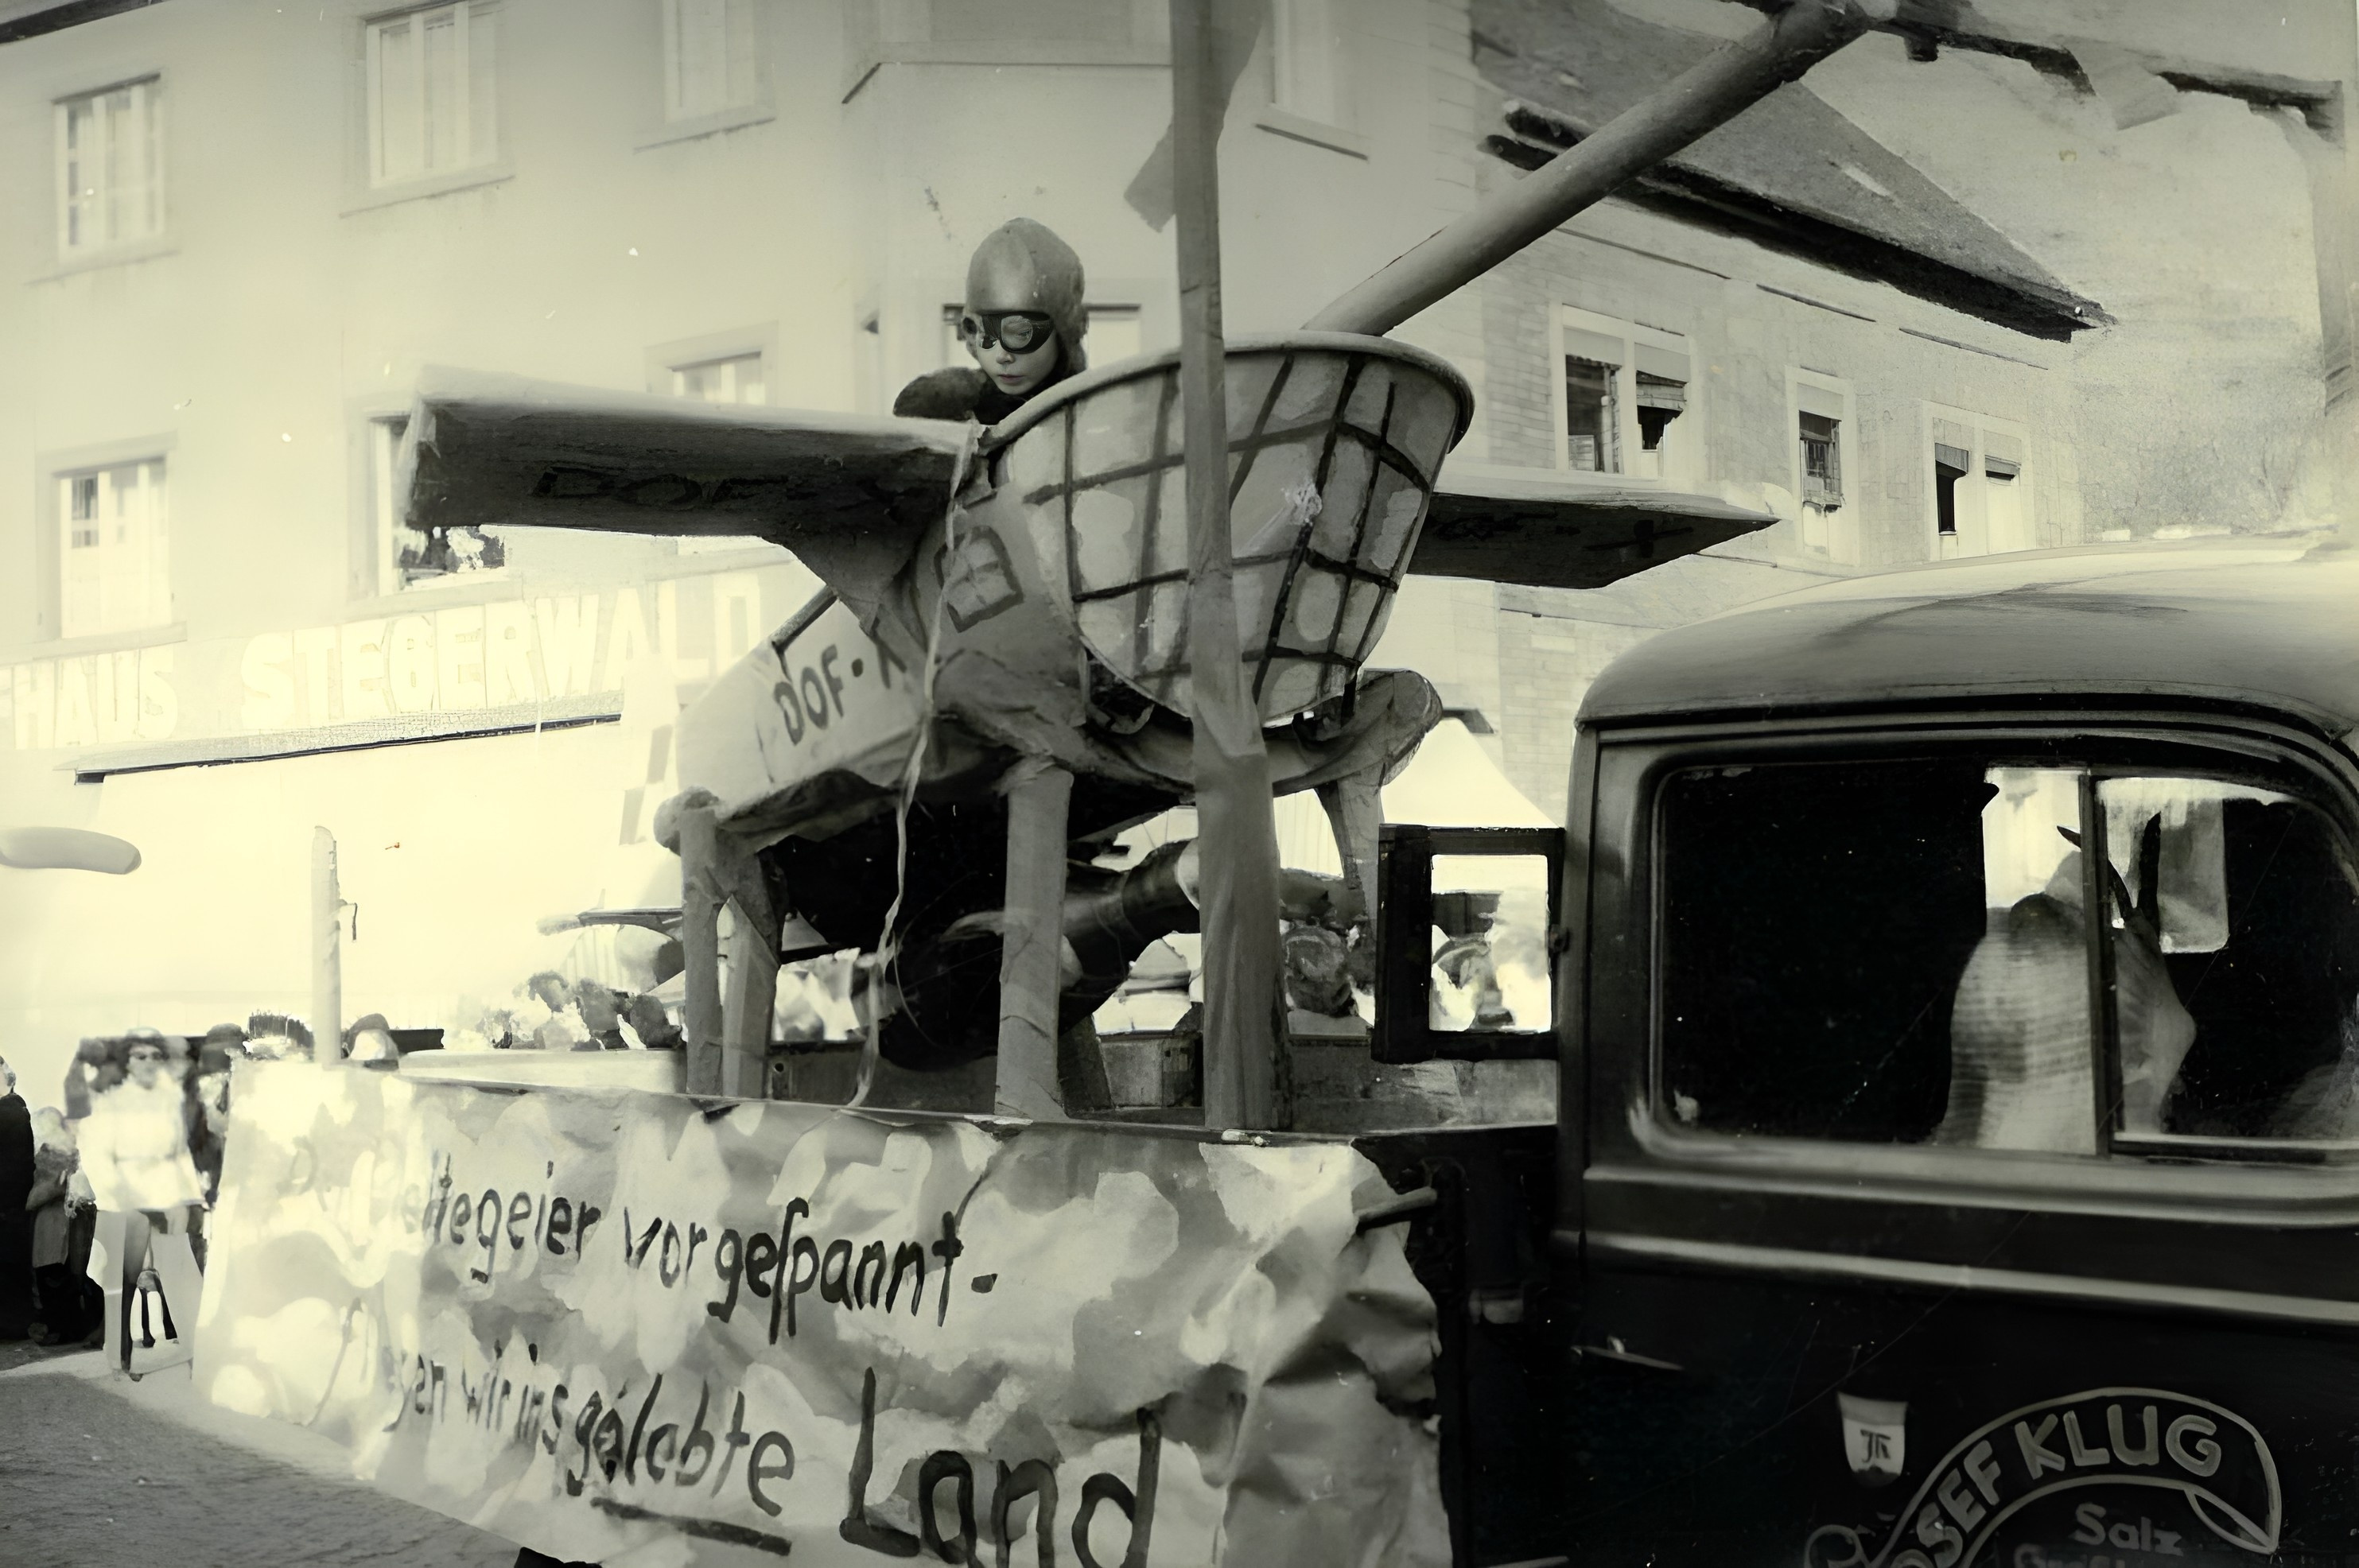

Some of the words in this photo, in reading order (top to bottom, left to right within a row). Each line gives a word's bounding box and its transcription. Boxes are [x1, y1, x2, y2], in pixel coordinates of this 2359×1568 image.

[839, 1366, 1164, 1568] Land
[1890, 1439, 2000, 1568] SEF
[2013, 1404, 2222, 1478] KLUG
[2071, 1501, 2184, 1557] Salz
